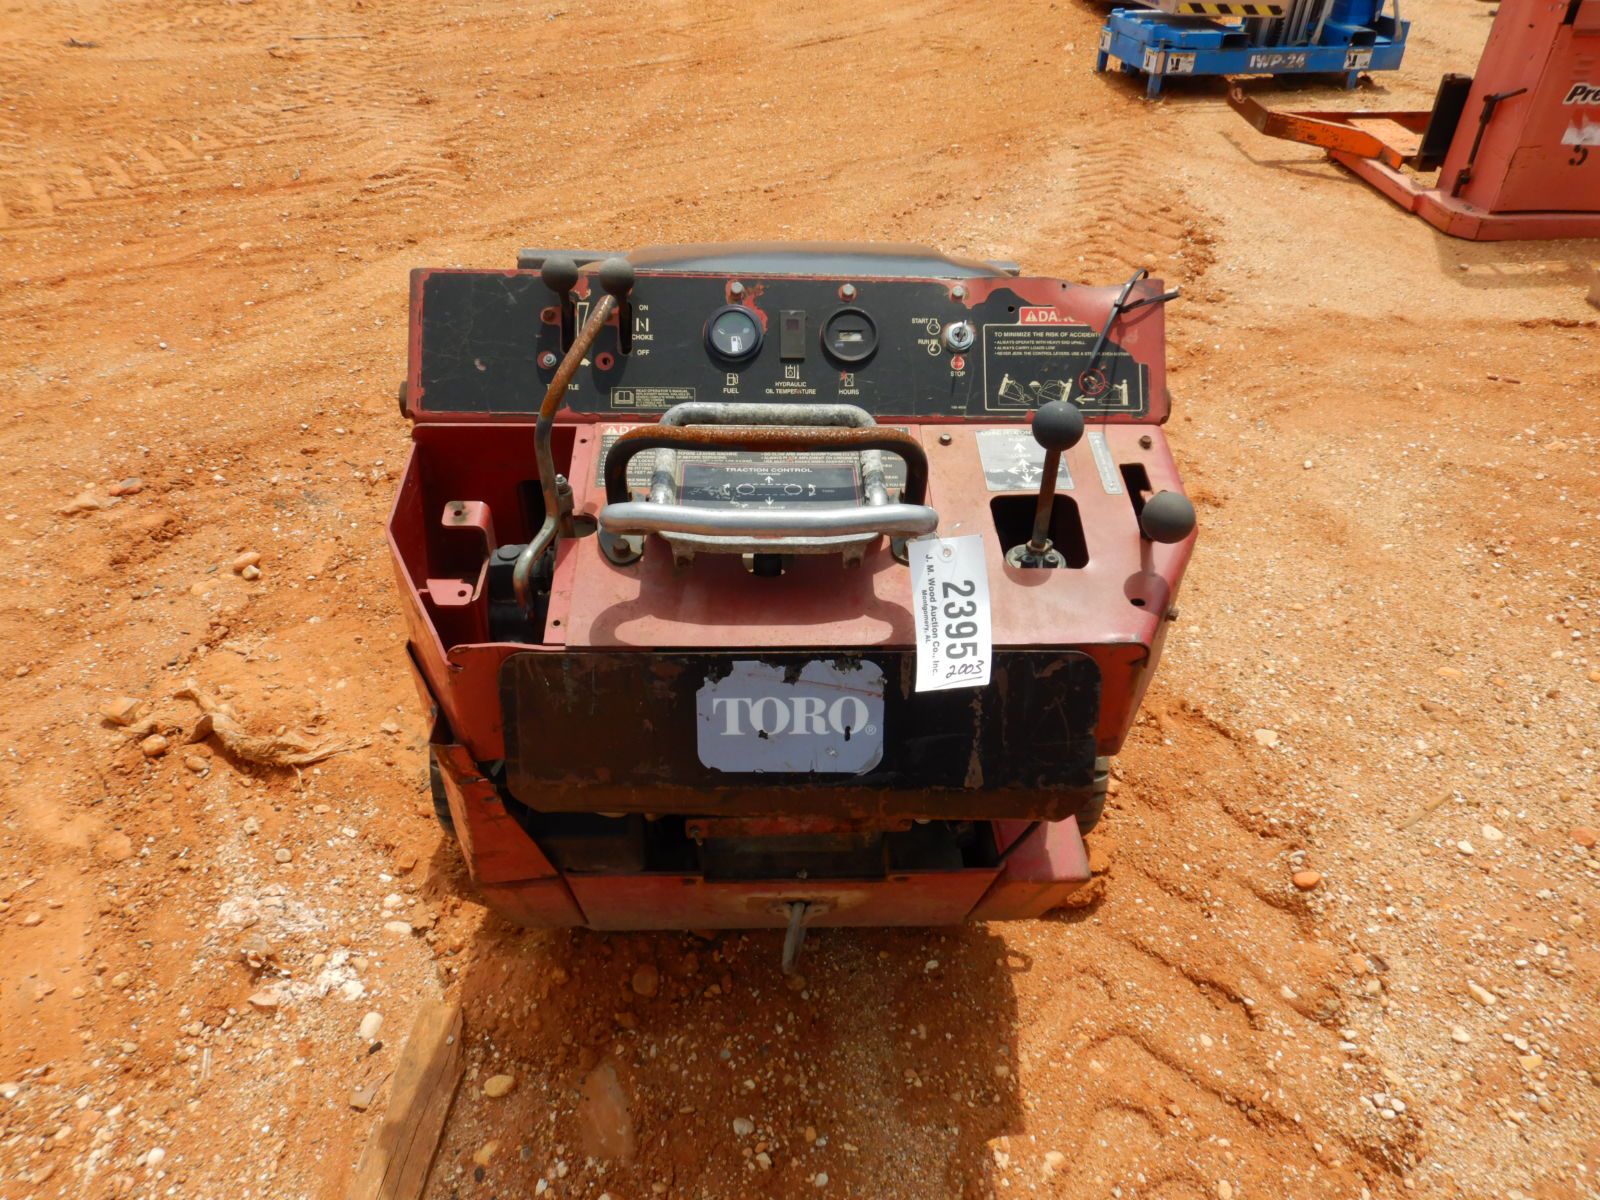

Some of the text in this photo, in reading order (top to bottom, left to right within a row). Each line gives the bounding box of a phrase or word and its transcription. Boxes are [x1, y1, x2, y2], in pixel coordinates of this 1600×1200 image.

[925, 554, 933, 563] J.
[926, 564, 935, 576] M.
[927, 577, 937, 603] Wood
[930, 605, 940, 639] Auction
[942, 579, 978, 660] 2395
[932, 640, 940, 658] Co.,
[945, 660, 985, 679] 2003
[712, 696, 870, 737] TORO
